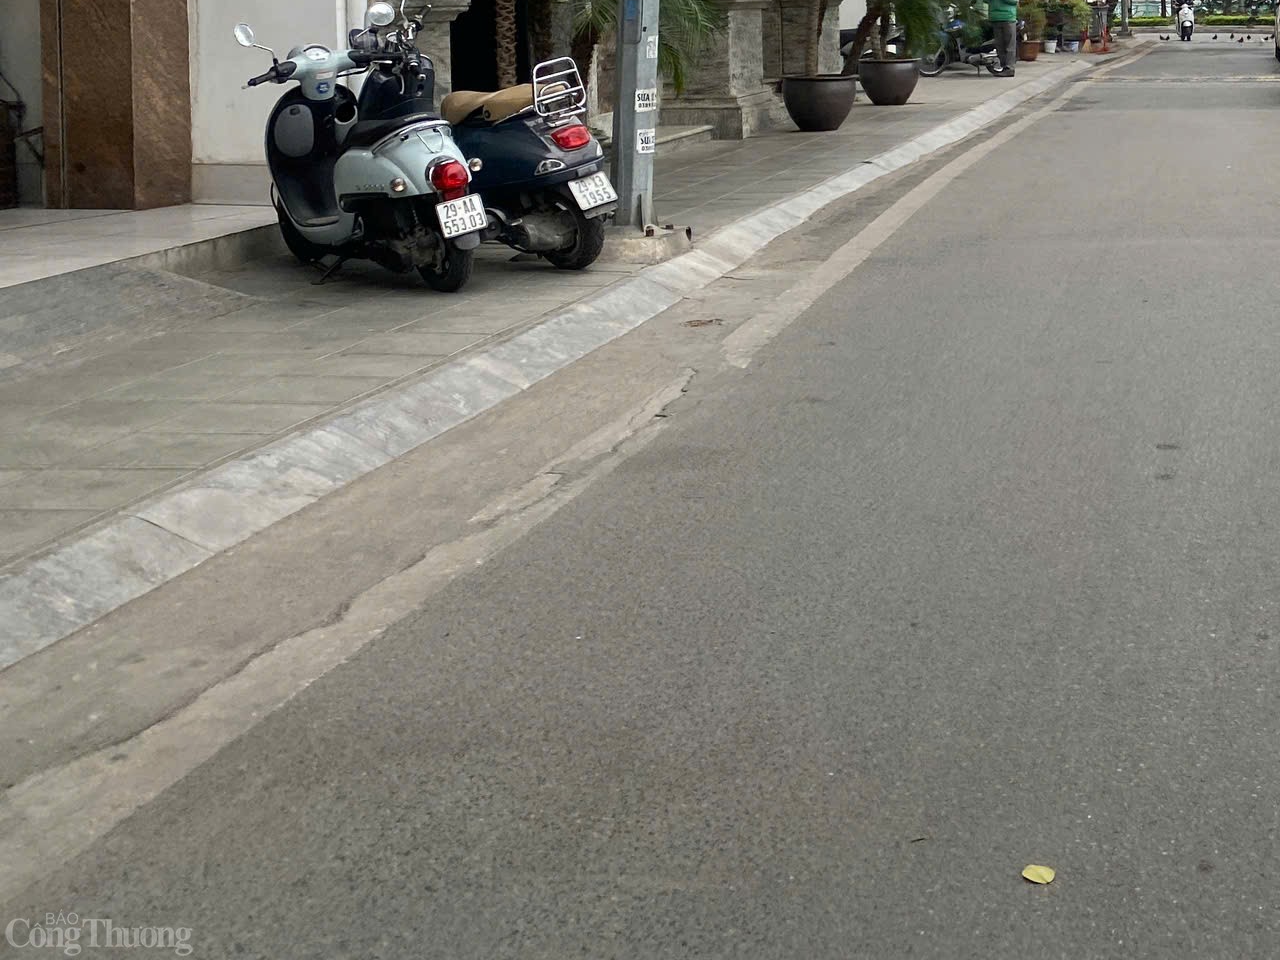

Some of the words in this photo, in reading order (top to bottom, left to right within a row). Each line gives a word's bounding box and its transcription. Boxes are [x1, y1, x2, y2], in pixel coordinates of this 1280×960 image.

[582, 187, 611, 205] 1955
[443, 198, 477, 219] 29-AA
[443, 212, 484, 235] 553.03
